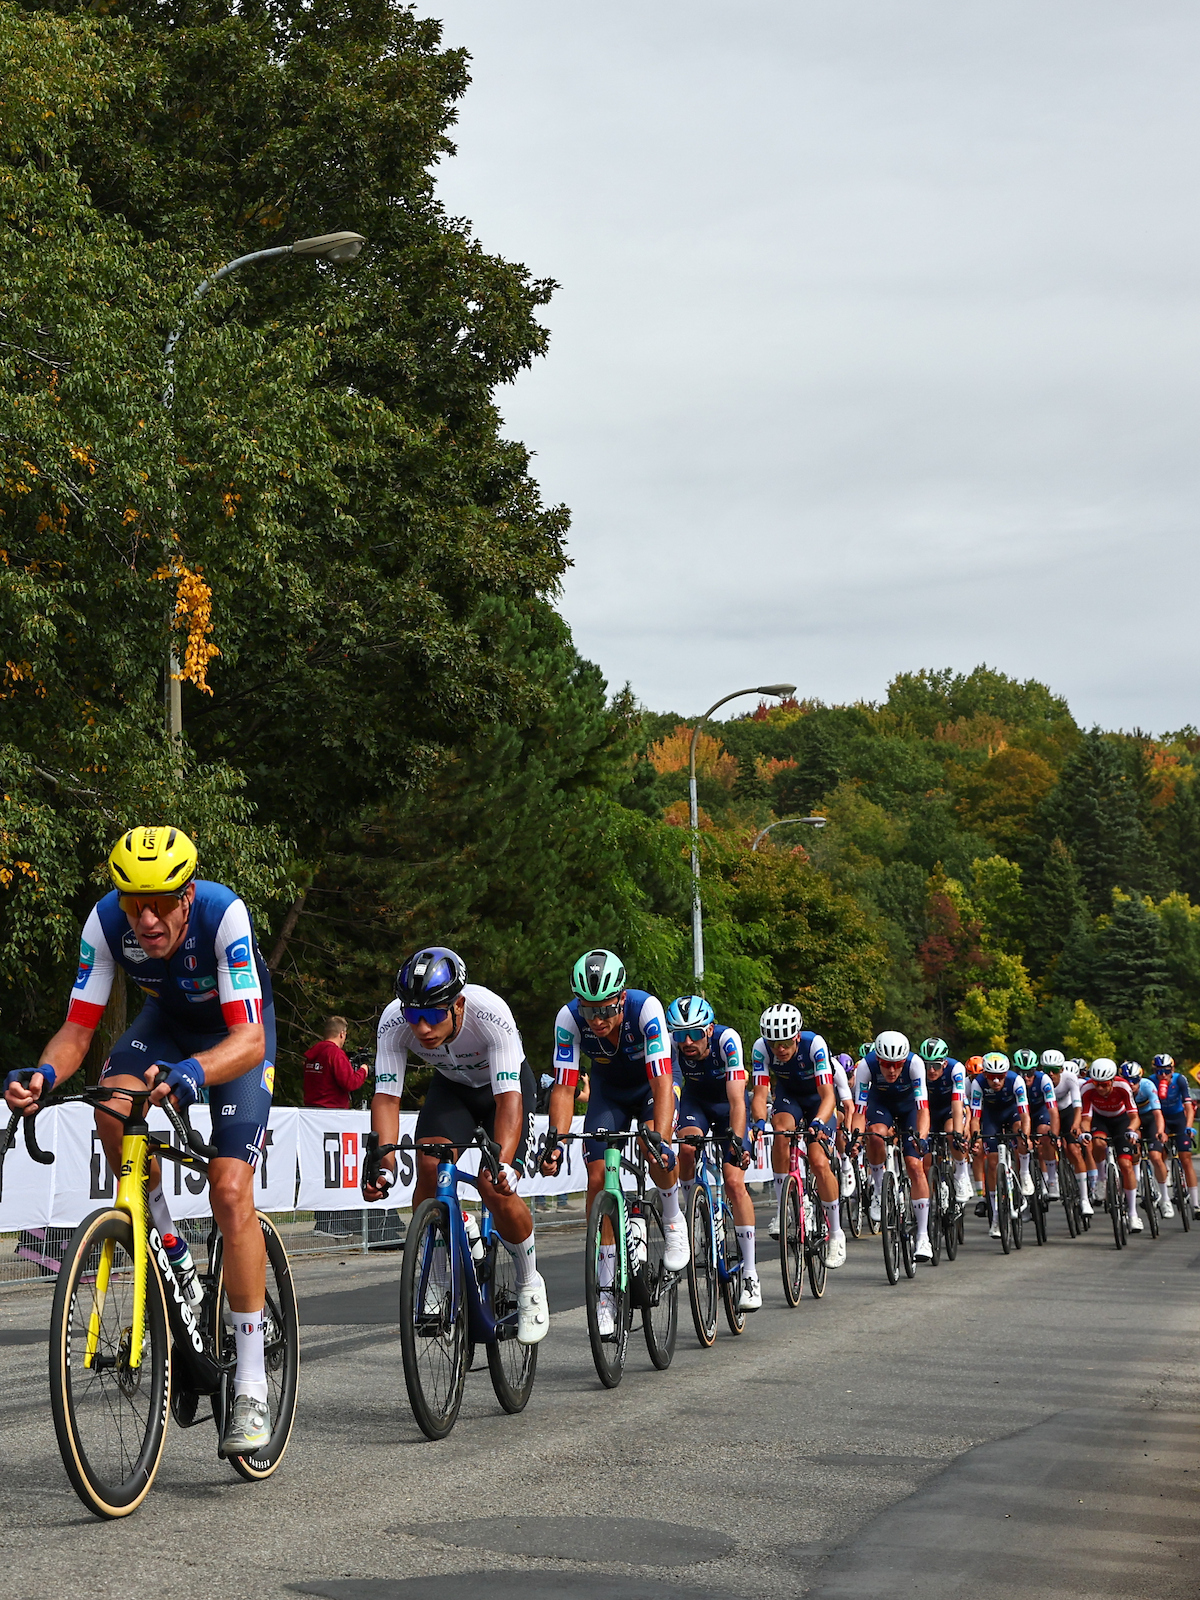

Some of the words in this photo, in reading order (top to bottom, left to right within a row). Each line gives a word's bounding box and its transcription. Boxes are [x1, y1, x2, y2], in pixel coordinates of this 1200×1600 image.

[376, 1016, 407, 1039] CONAD
[476, 1010, 514, 1036] CONADE
[149, 1227, 204, 1353] cervélo
